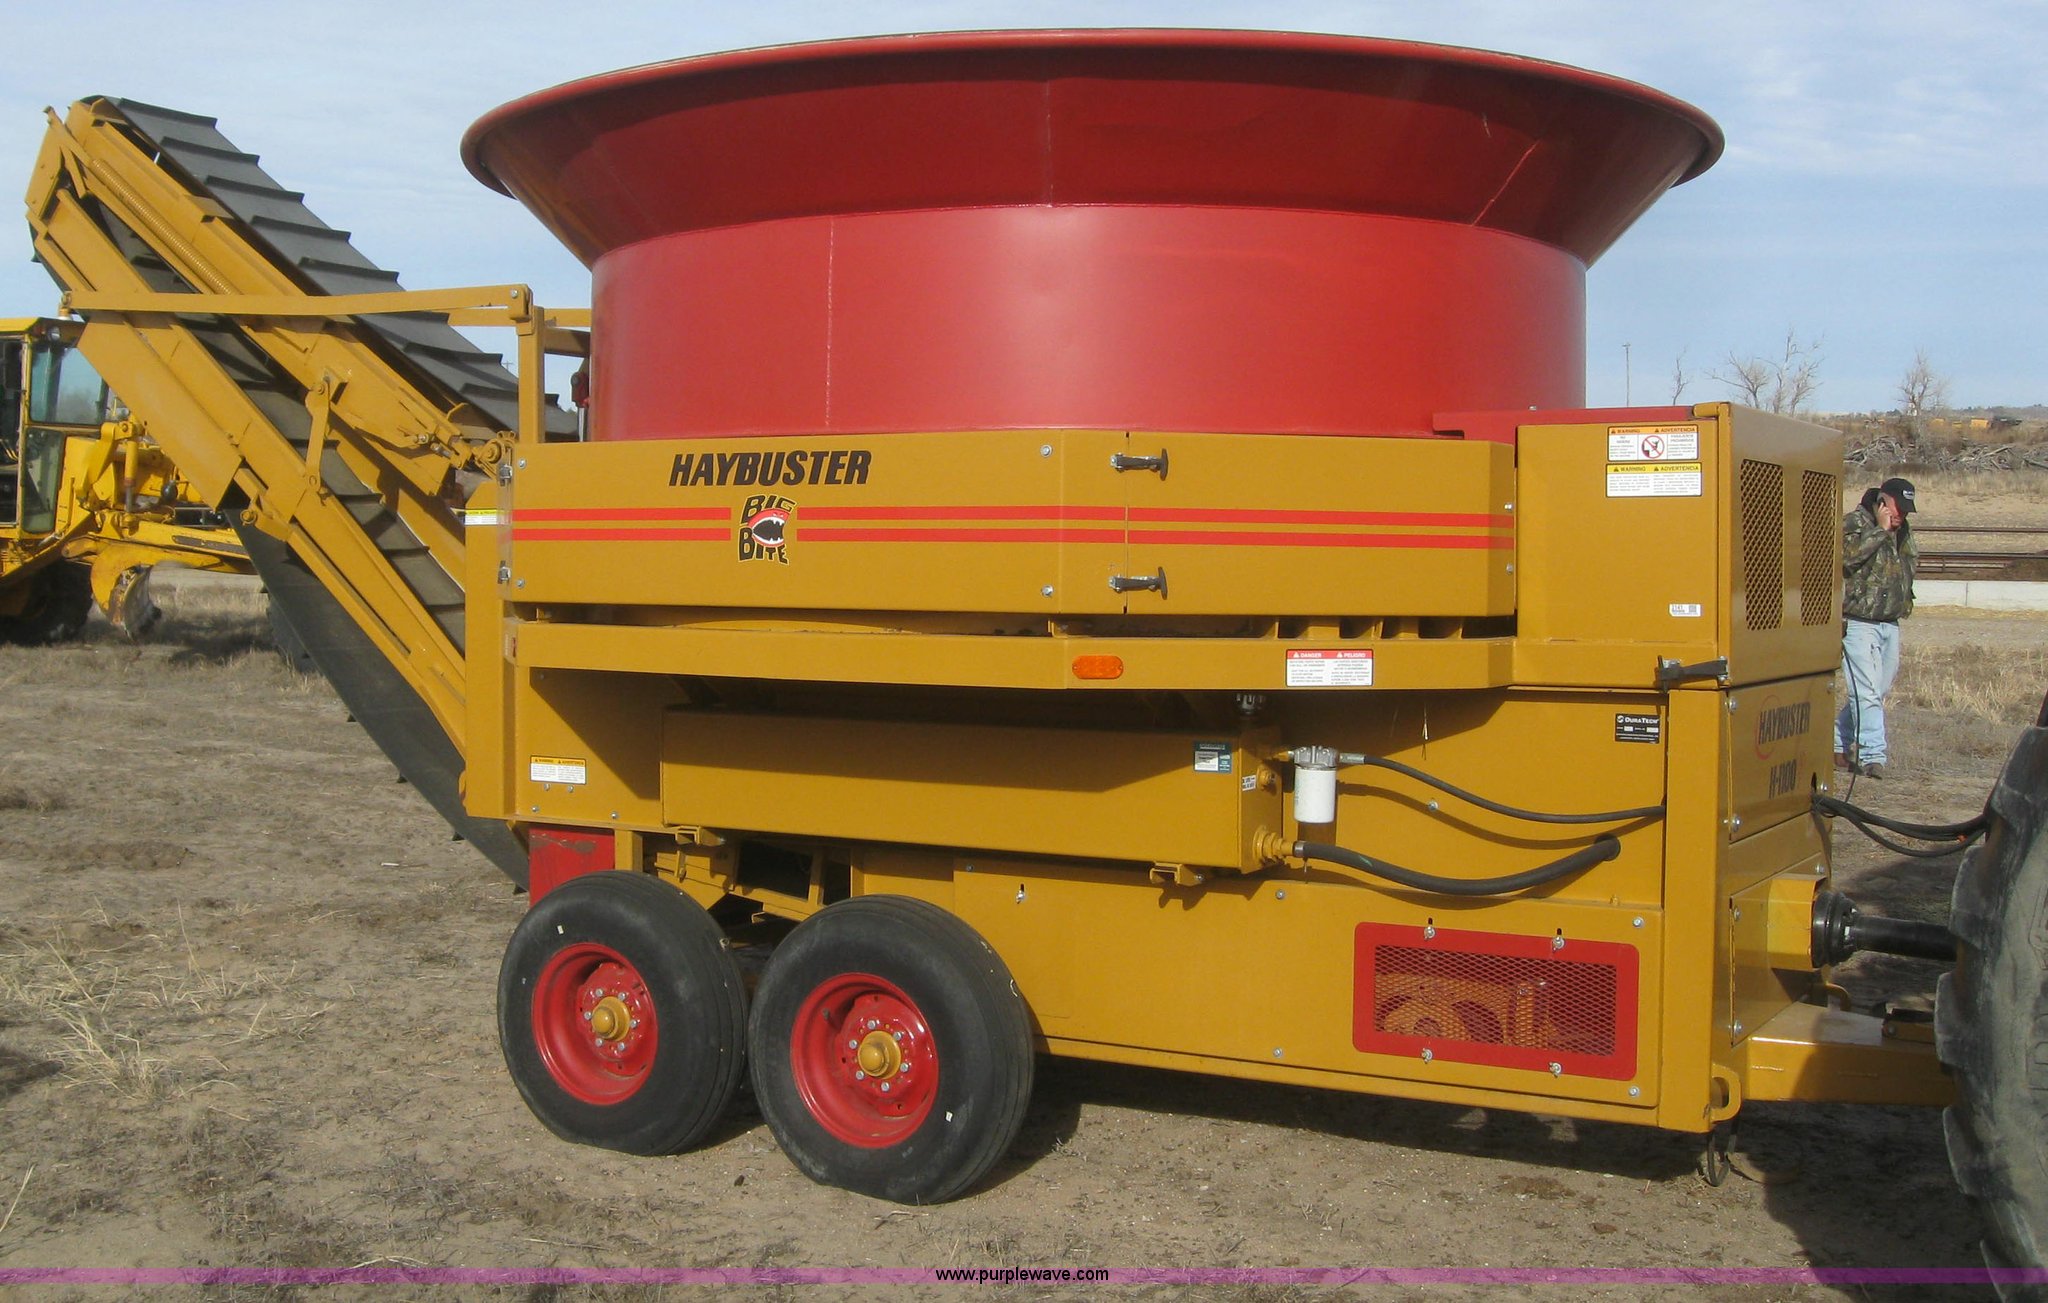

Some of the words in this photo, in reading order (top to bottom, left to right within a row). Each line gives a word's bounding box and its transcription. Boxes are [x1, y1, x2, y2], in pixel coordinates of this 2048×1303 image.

[669, 450, 872, 487] HAYBUSTER
[741, 495, 797, 524] BIG
[739, 527, 788, 565] BITE
[1758, 701, 1811, 745] HAYBUSTER
[1768, 758, 1797, 800] H-1100
